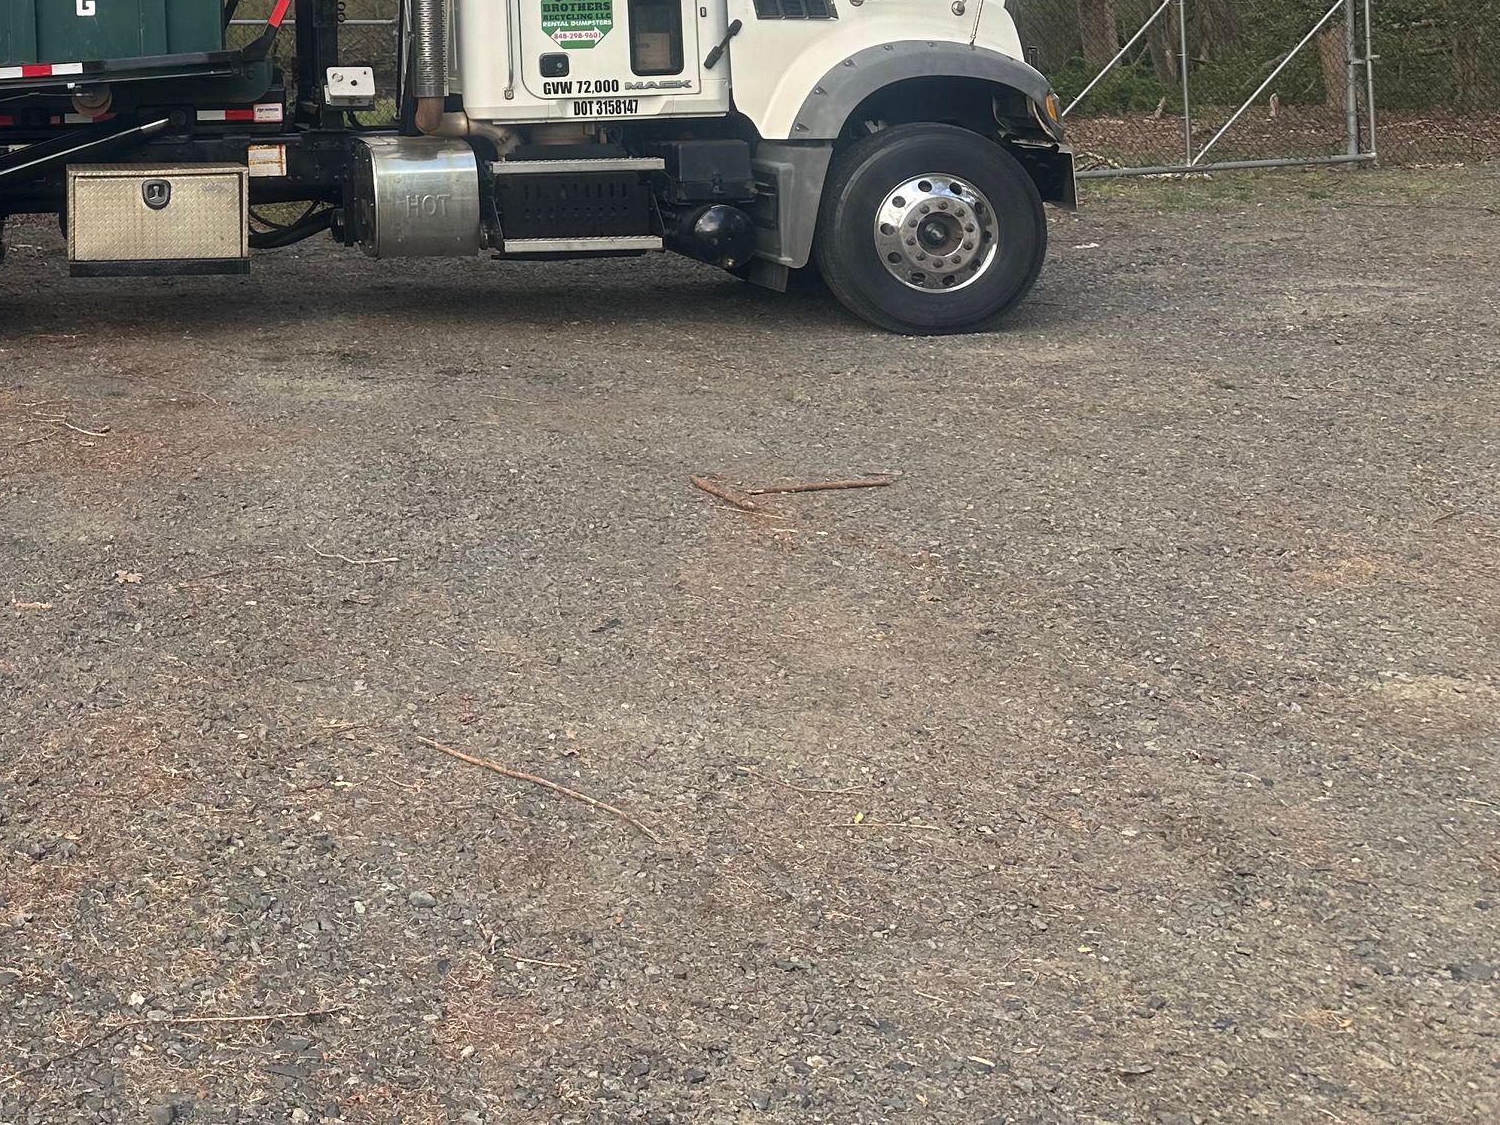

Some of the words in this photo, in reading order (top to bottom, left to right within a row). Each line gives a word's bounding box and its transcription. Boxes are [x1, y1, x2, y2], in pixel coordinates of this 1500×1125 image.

[542, 1, 611, 12] BROTHERS
[543, 13, 594, 21] RECYCLING
[553, 31, 601, 40] 848-298-9601
[543, 81, 573, 95] GVW
[576, 79, 619, 95] 72,000
[624, 80, 692, 91] MACK
[573, 100, 594, 116] DOT
[596, 99, 639, 115] 3158147
[406, 193, 451, 218] HOT
